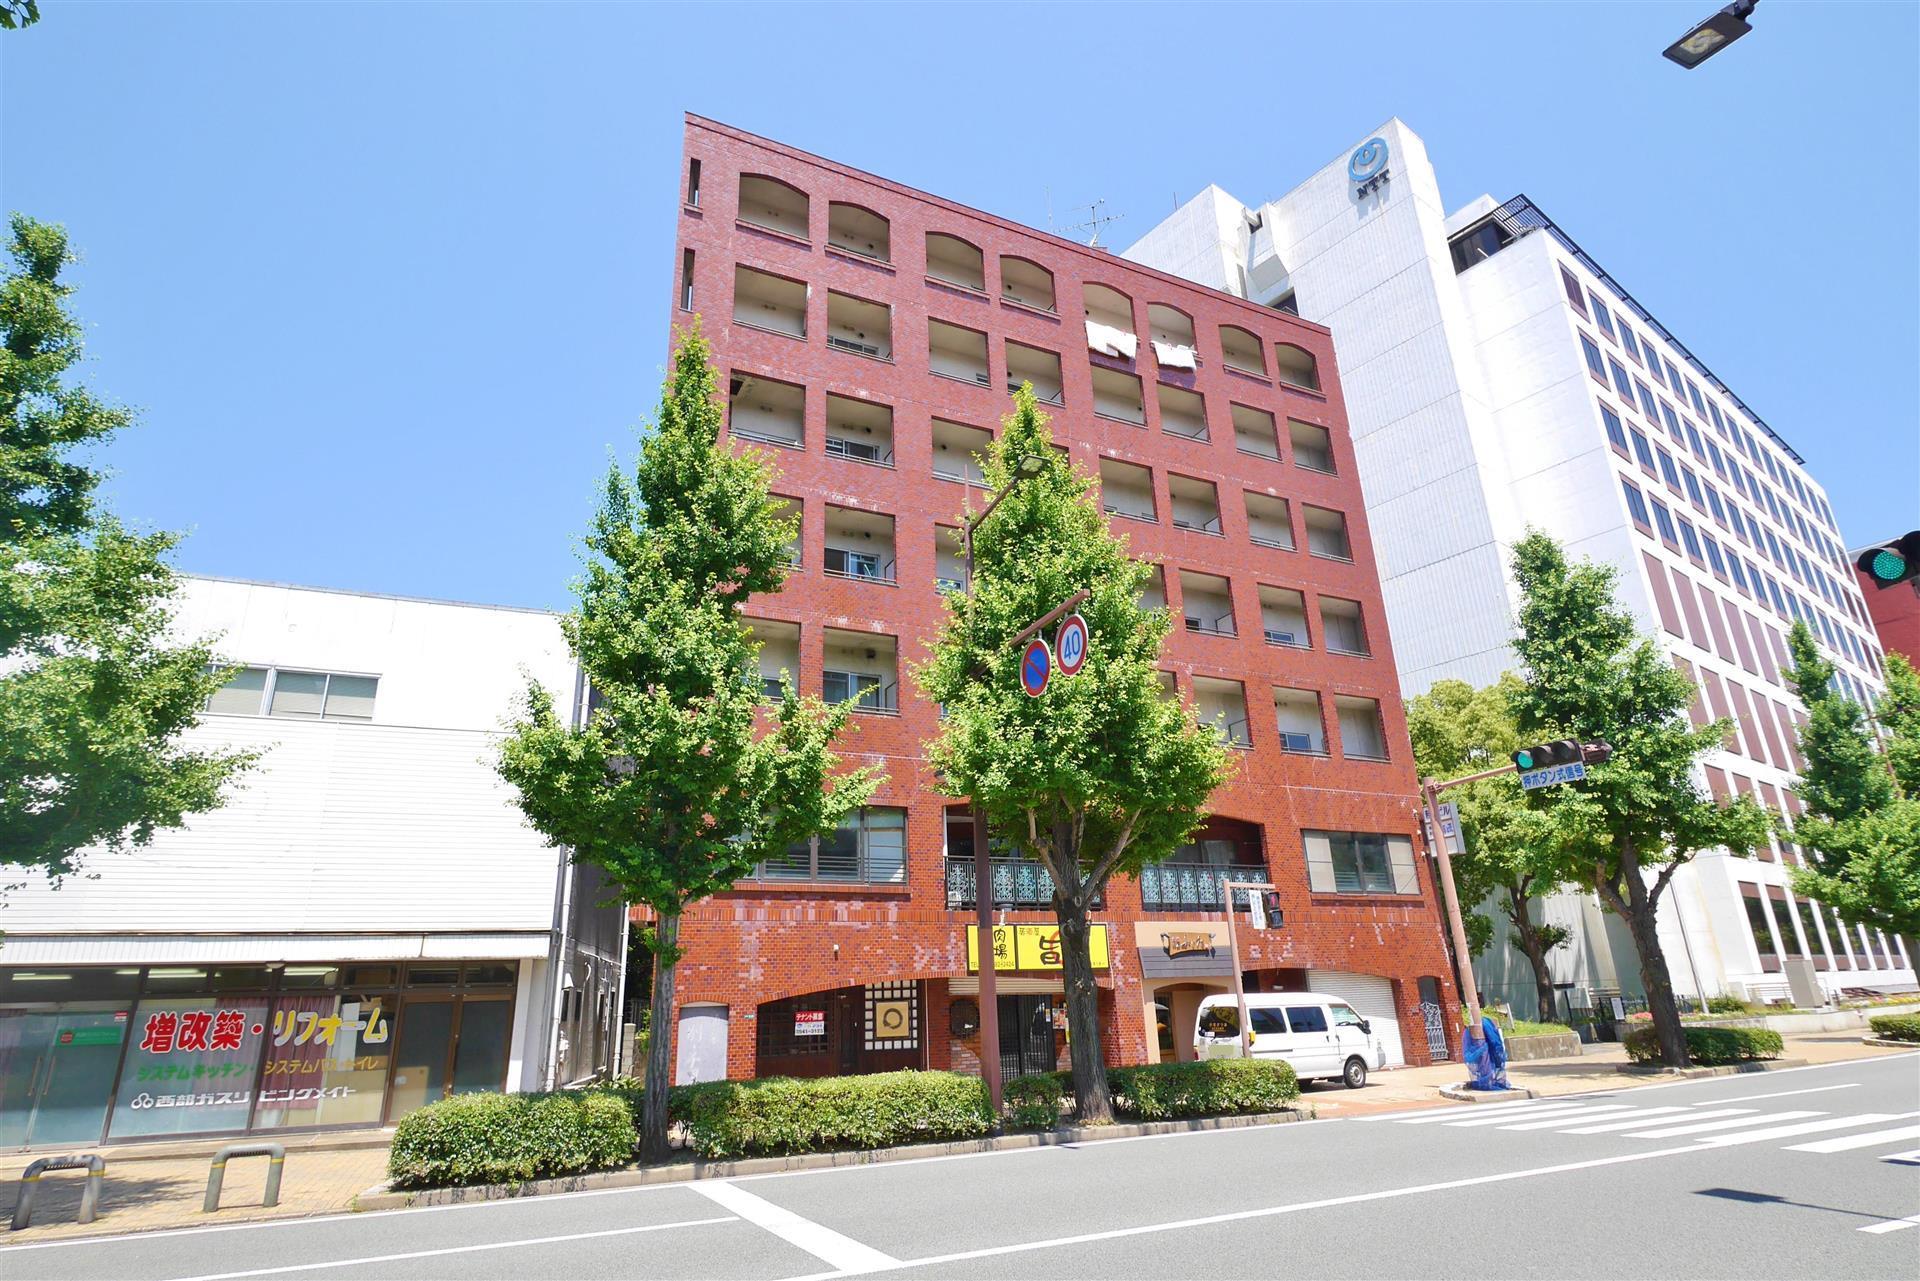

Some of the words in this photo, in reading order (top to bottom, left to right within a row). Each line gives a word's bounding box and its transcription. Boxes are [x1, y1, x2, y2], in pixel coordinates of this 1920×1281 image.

[1357, 168, 1390, 200] NTT
[1064, 630, 1080, 660] 40
[1522, 763, 1584, 788] 押ボタン式信号
